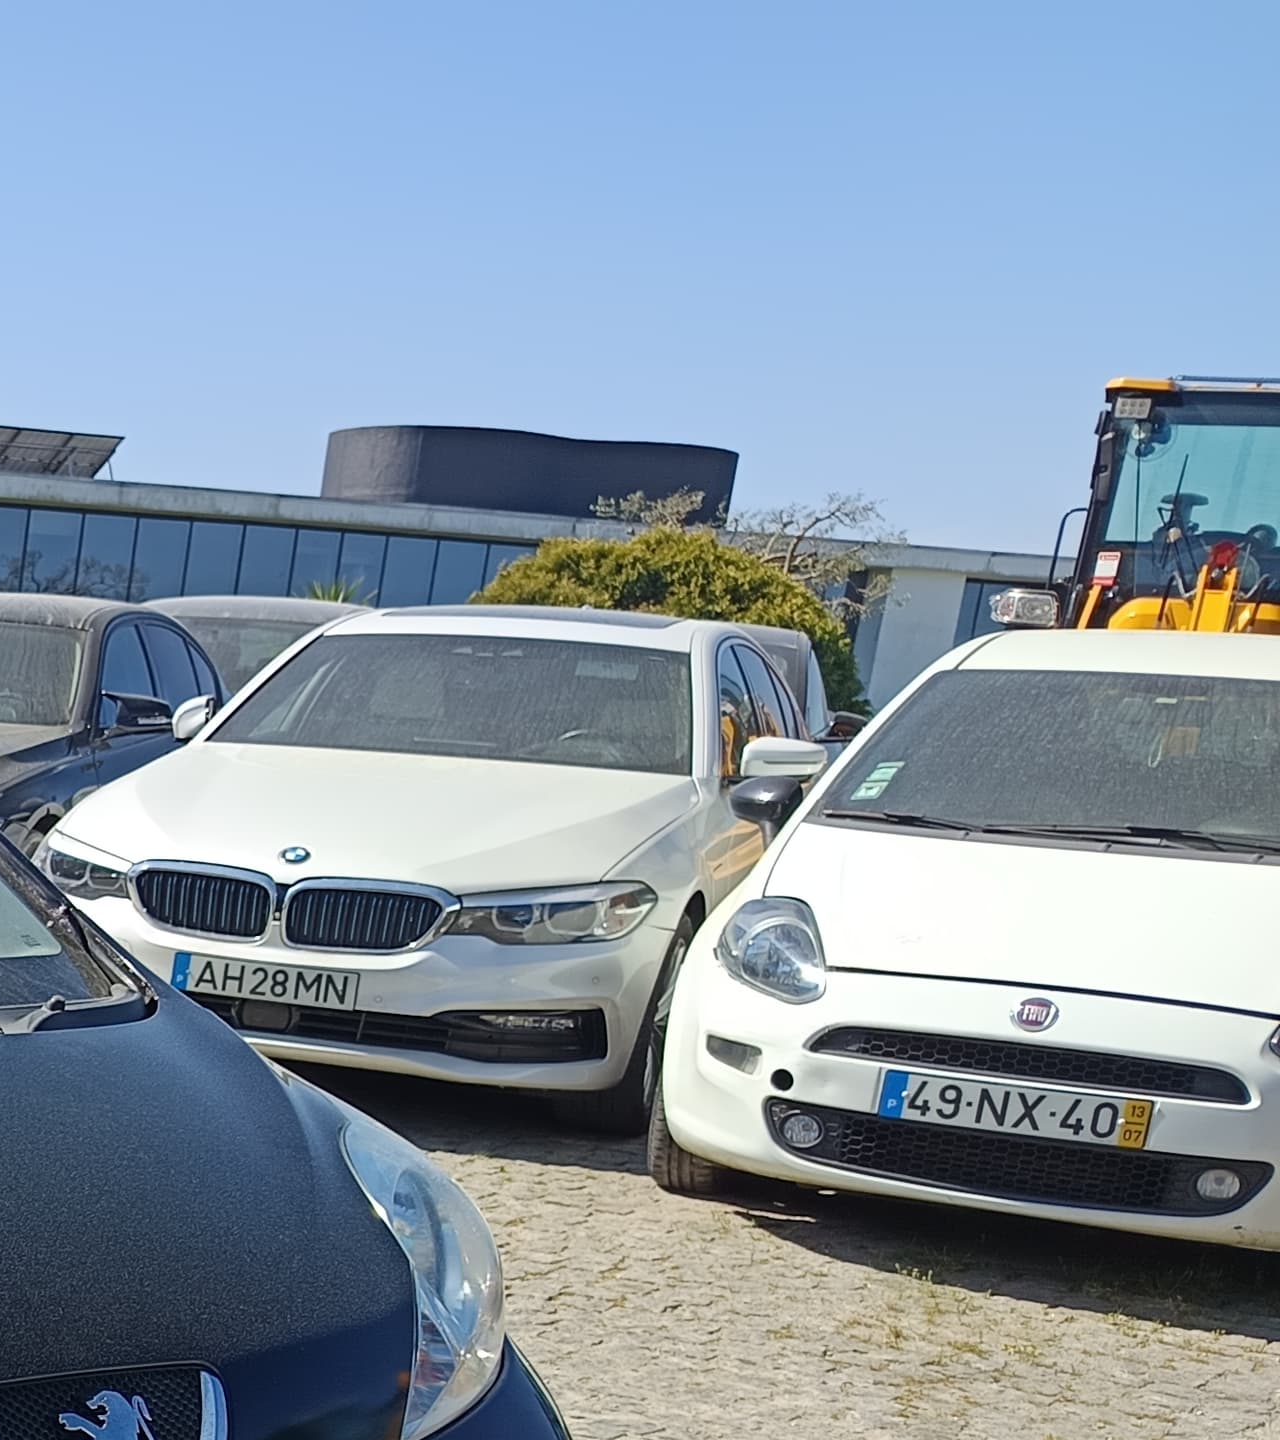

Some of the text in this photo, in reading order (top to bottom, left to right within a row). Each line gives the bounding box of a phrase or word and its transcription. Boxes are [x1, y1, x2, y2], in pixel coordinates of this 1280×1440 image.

[194, 960, 349, 1005] AH28MN
[887, 1098, 897, 1110] P
[1130, 1104, 1146, 1119] 13
[1123, 1128, 1143, 1143] 07
